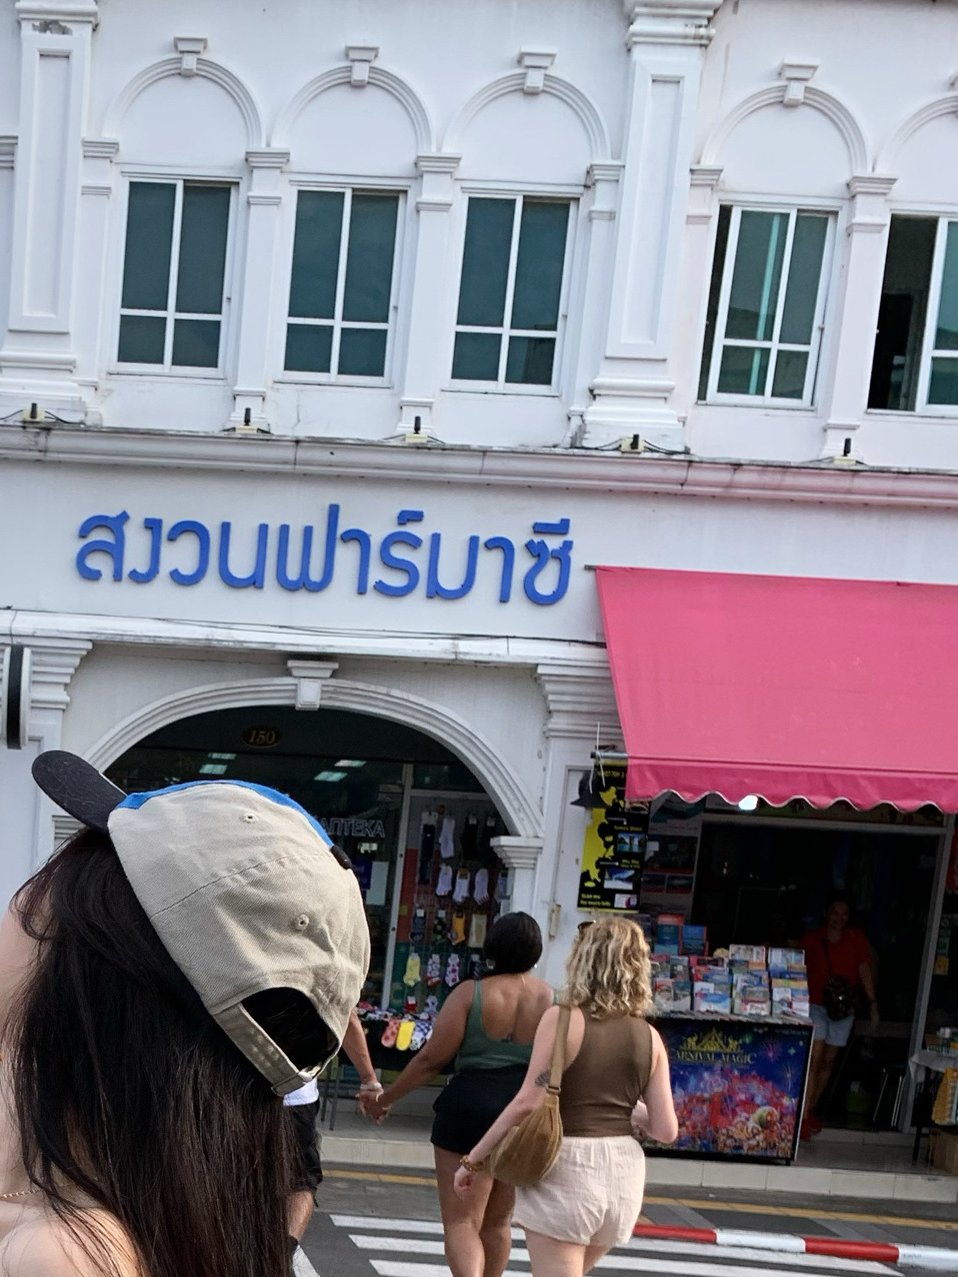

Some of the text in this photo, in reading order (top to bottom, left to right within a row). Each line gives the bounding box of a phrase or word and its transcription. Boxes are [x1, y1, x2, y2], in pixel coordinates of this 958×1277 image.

[76, 503, 574, 605] สงวนฟาร์มาซี
[249, 729, 276, 744] 150
